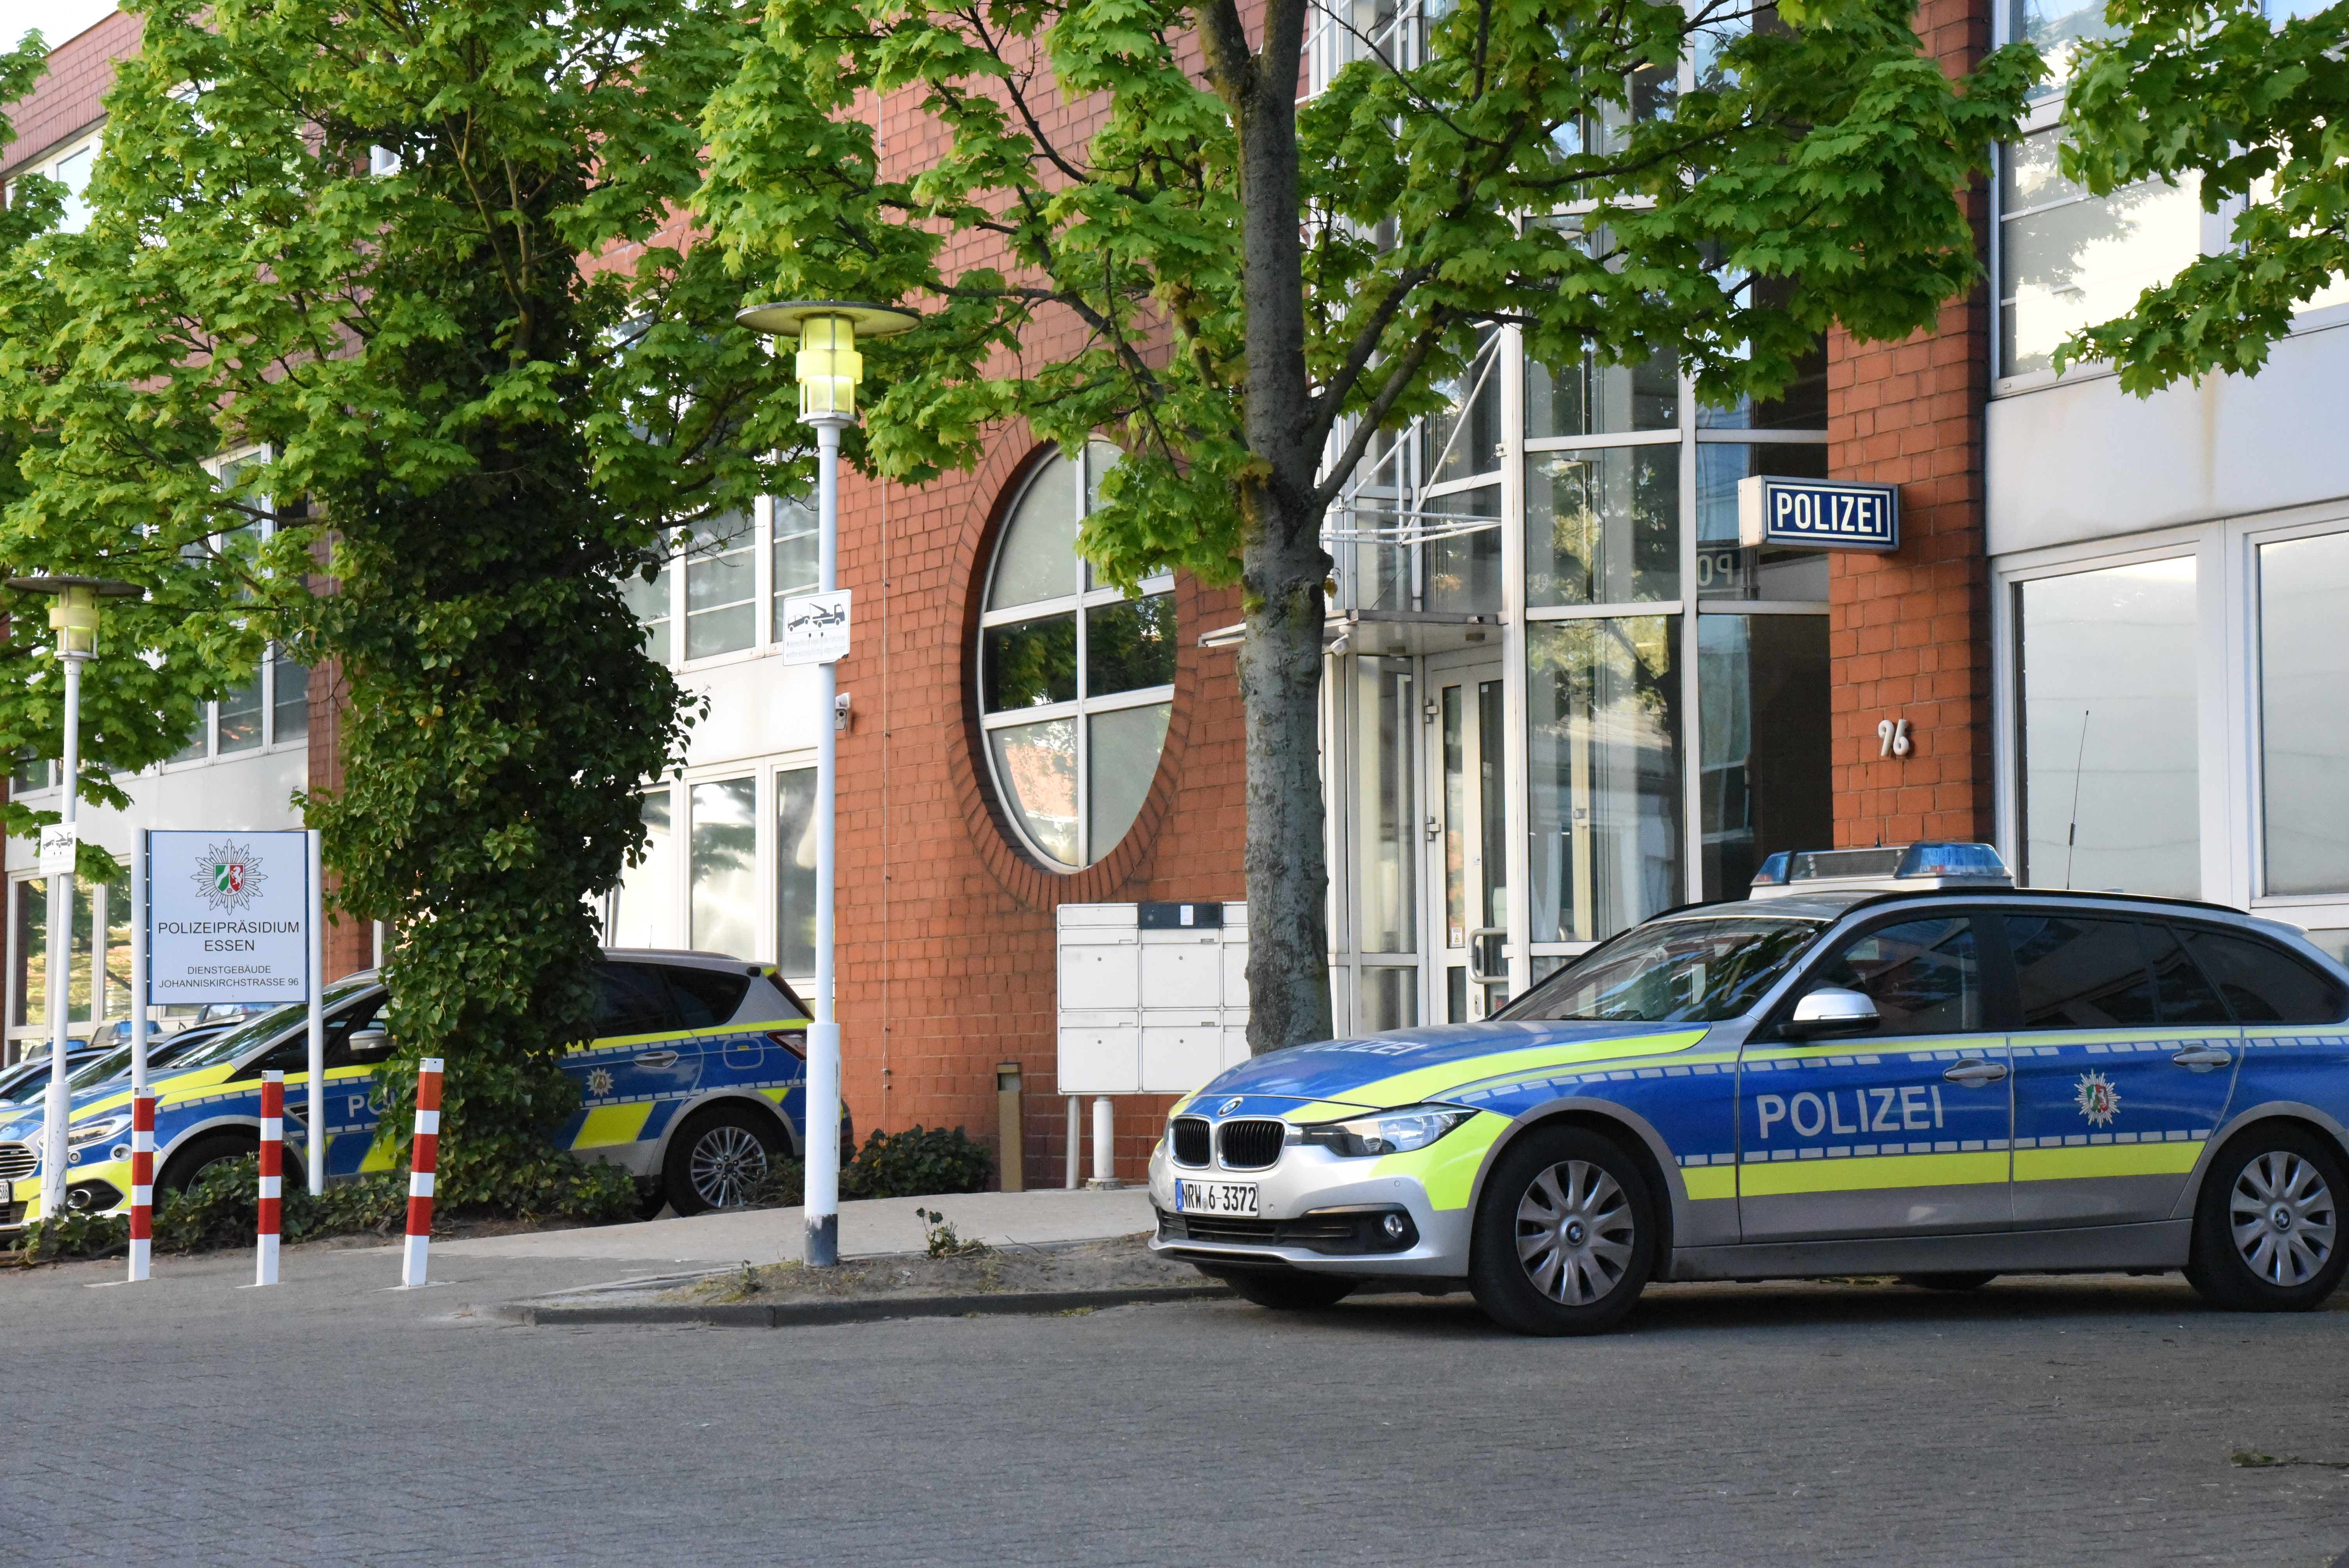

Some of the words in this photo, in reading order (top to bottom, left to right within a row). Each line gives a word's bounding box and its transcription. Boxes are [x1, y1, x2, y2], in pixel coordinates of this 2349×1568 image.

[1777, 492, 1881, 533] POLIZEI
[1878, 719, 1909, 756] 96
[158, 920, 299, 934] POLIZEIPRÄSIDIUM
[205, 940, 255, 951] ESSEN
[188, 964, 271, 974] DIENSTGEBÄUDE
[159, 978, 285, 988] JOHANNISKIRCHSTRASSE
[1757, 1085, 1943, 1139] POLIZEI
[1182, 1183, 1201, 1209] NRW
[1208, 1185, 1257, 1212] 6-3372
